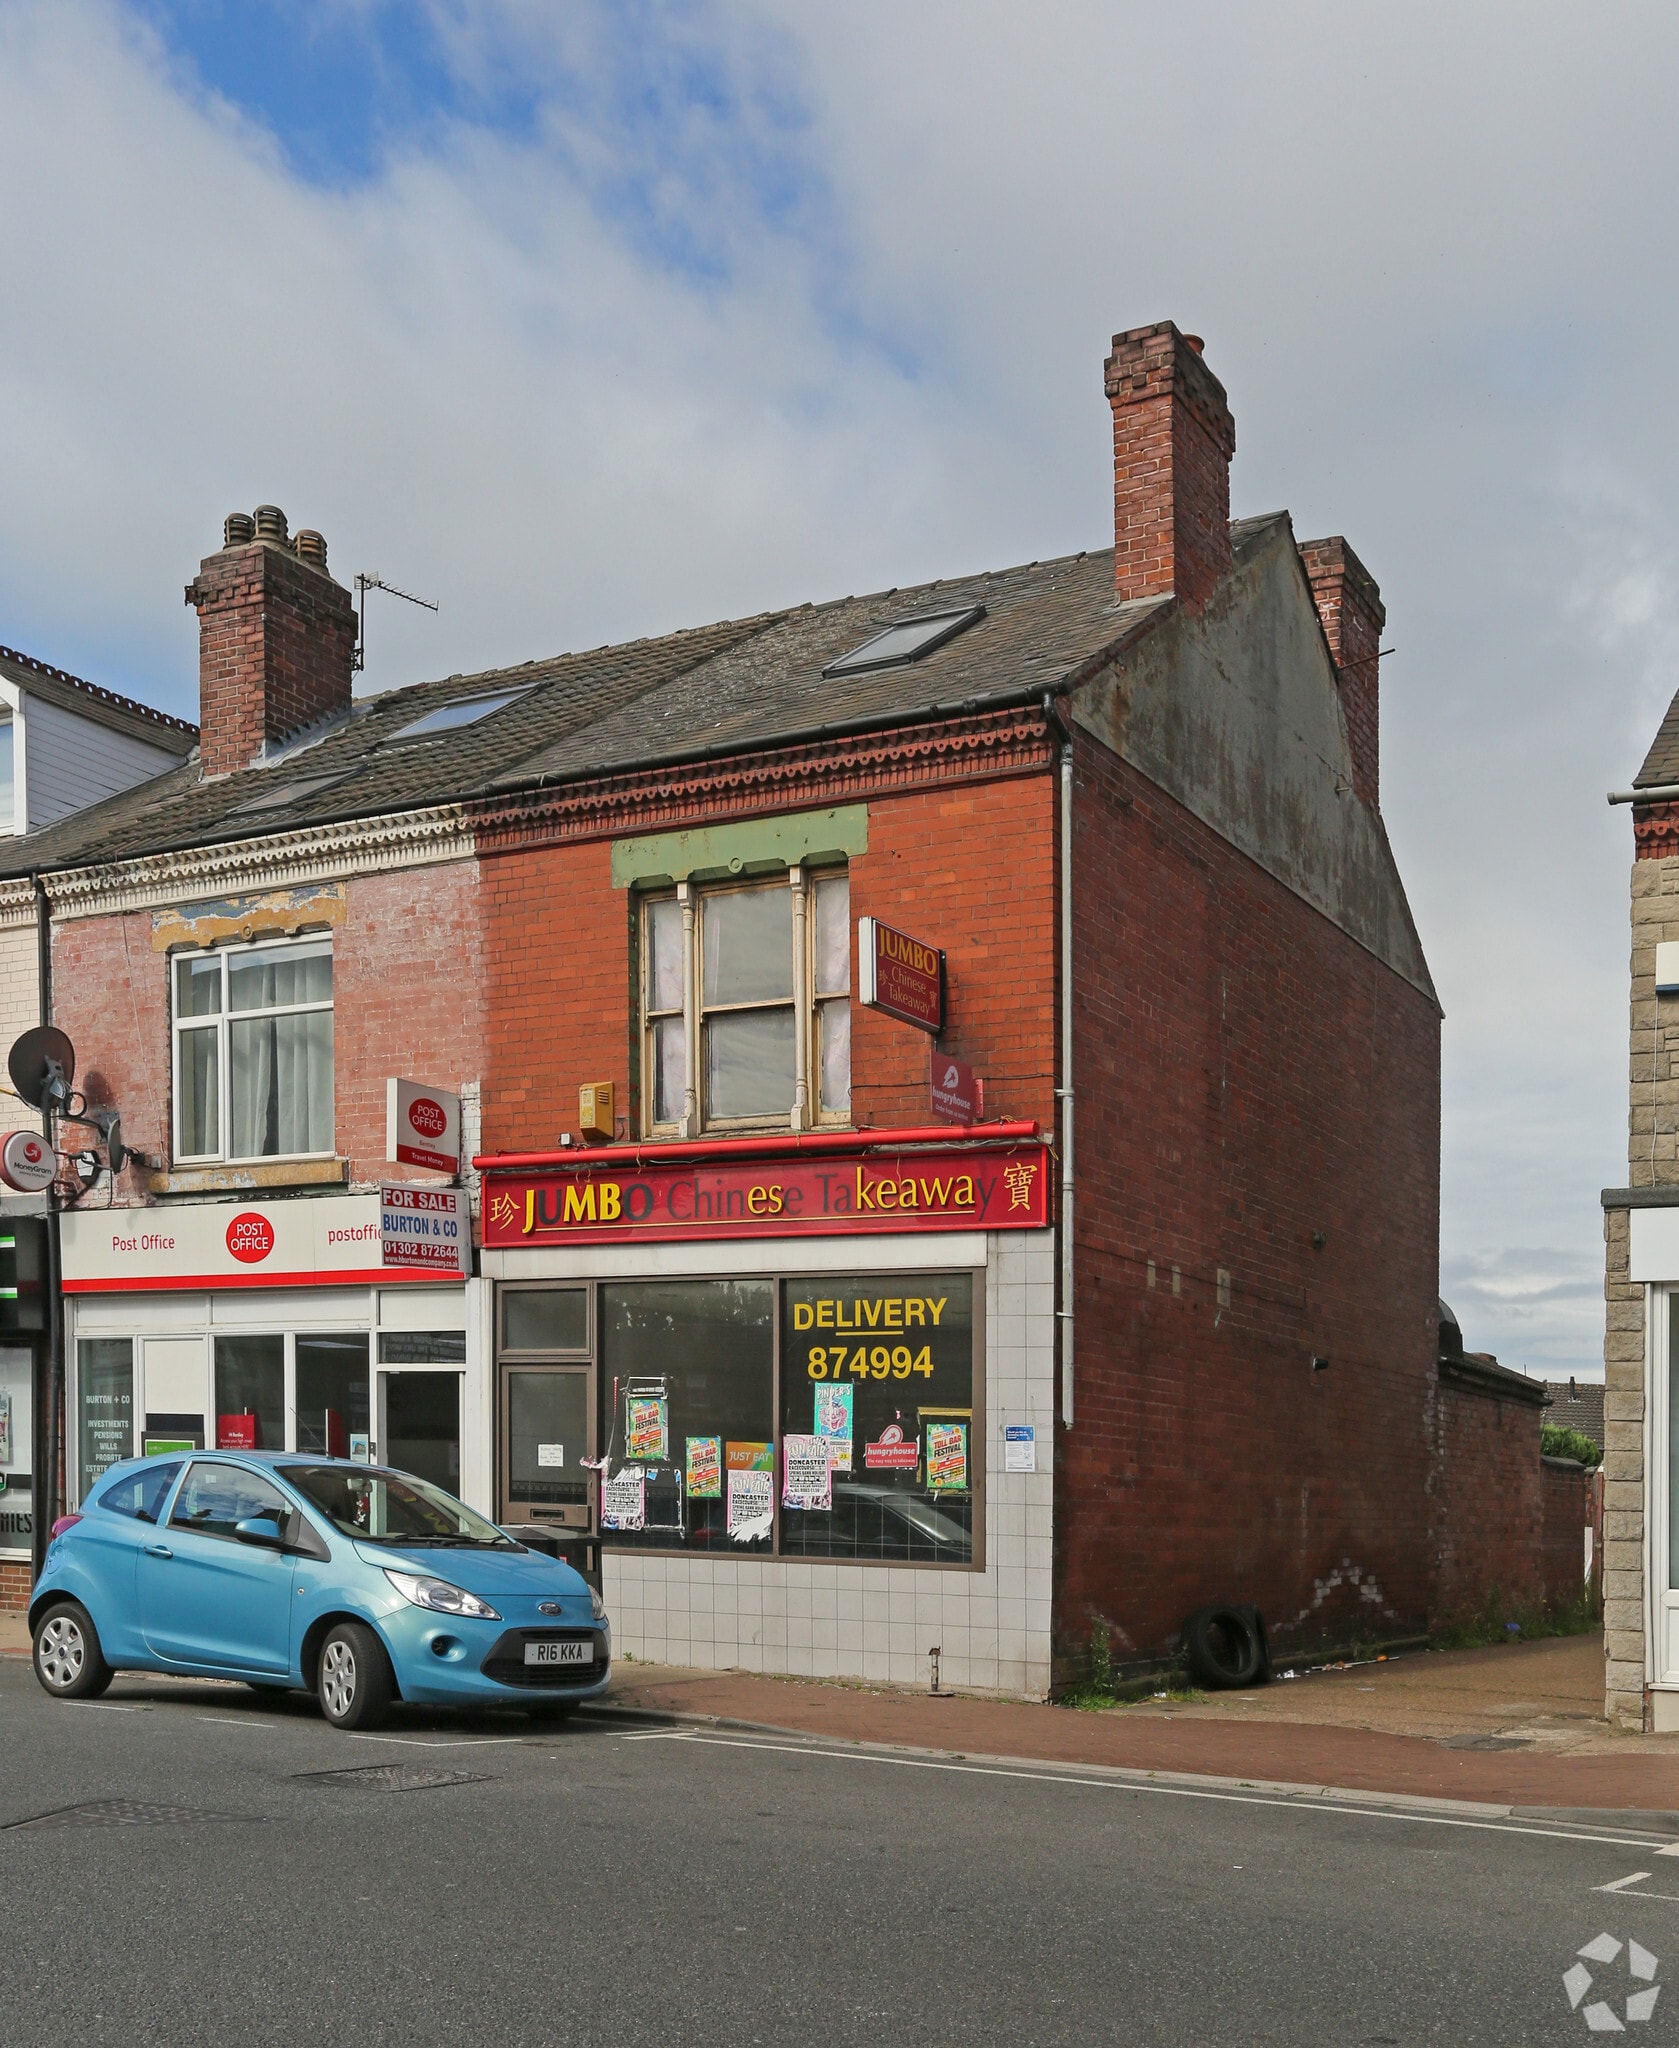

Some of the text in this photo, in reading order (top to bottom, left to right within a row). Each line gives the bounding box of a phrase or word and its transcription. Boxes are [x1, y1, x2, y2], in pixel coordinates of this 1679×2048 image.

[879, 927, 937, 976] JUMBO
[891, 966, 926, 995] Chinese
[888, 982, 930, 1019] Takeaway
[932, 1085, 970, 1110] hungryhouse
[417, 1104, 440, 1119] POST
[412, 1115, 443, 1131] OFFICE
[411, 1152, 444, 1167] Travel Money
[13, 1161, 52, 1175] MoneyGram
[383, 1189, 456, 1212] FOR SALE
[490, 1162, 1038, 1234] 珍 JUMBO Chinese Takeaway 寶
[236, 1222, 265, 1236] POST
[383, 1214, 458, 1238] BURTON & CO
[112, 1234, 175, 1251] Post Office
[230, 1236, 269, 1251] OFFICE
[384, 1241, 458, 1259] 01302 872644
[794, 1297, 948, 1331] DELIVERY
[807, 1345, 934, 1380] 874994
[86, 1395, 112, 1404] BURTON
[120, 1395, 130, 1404] CO
[635, 1409, 659, 1422] TOLL BAR
[87, 1420, 129, 1428] INVESTMENTS
[635, 1417, 659, 1430] FESTIVAL
[94, 1431, 123, 1439] PENSIONS
[934, 1435, 961, 1449] TOLL BAR
[99, 1442, 118, 1450] WILLS
[788, 1444, 807, 1458] FUN
[808, 1444, 826, 1457] FAIR
[867, 1446, 915, 1456] hungryhouse
[934, 1443, 962, 1458] FESTIVAL
[95, 1453, 122, 1461] PROBATE
[692, 1447, 717, 1460] TOLL BAR
[729, 1450, 771, 1462] JUST EAT
[692, 1455, 716, 1468] FESTIVAL
[732, 1479, 750, 1493] FUN
[751, 1480, 770, 1492] FAIR
[732, 1493, 769, 1501] DONCASTER
[538, 1643, 583, 1661] R16 KKA
